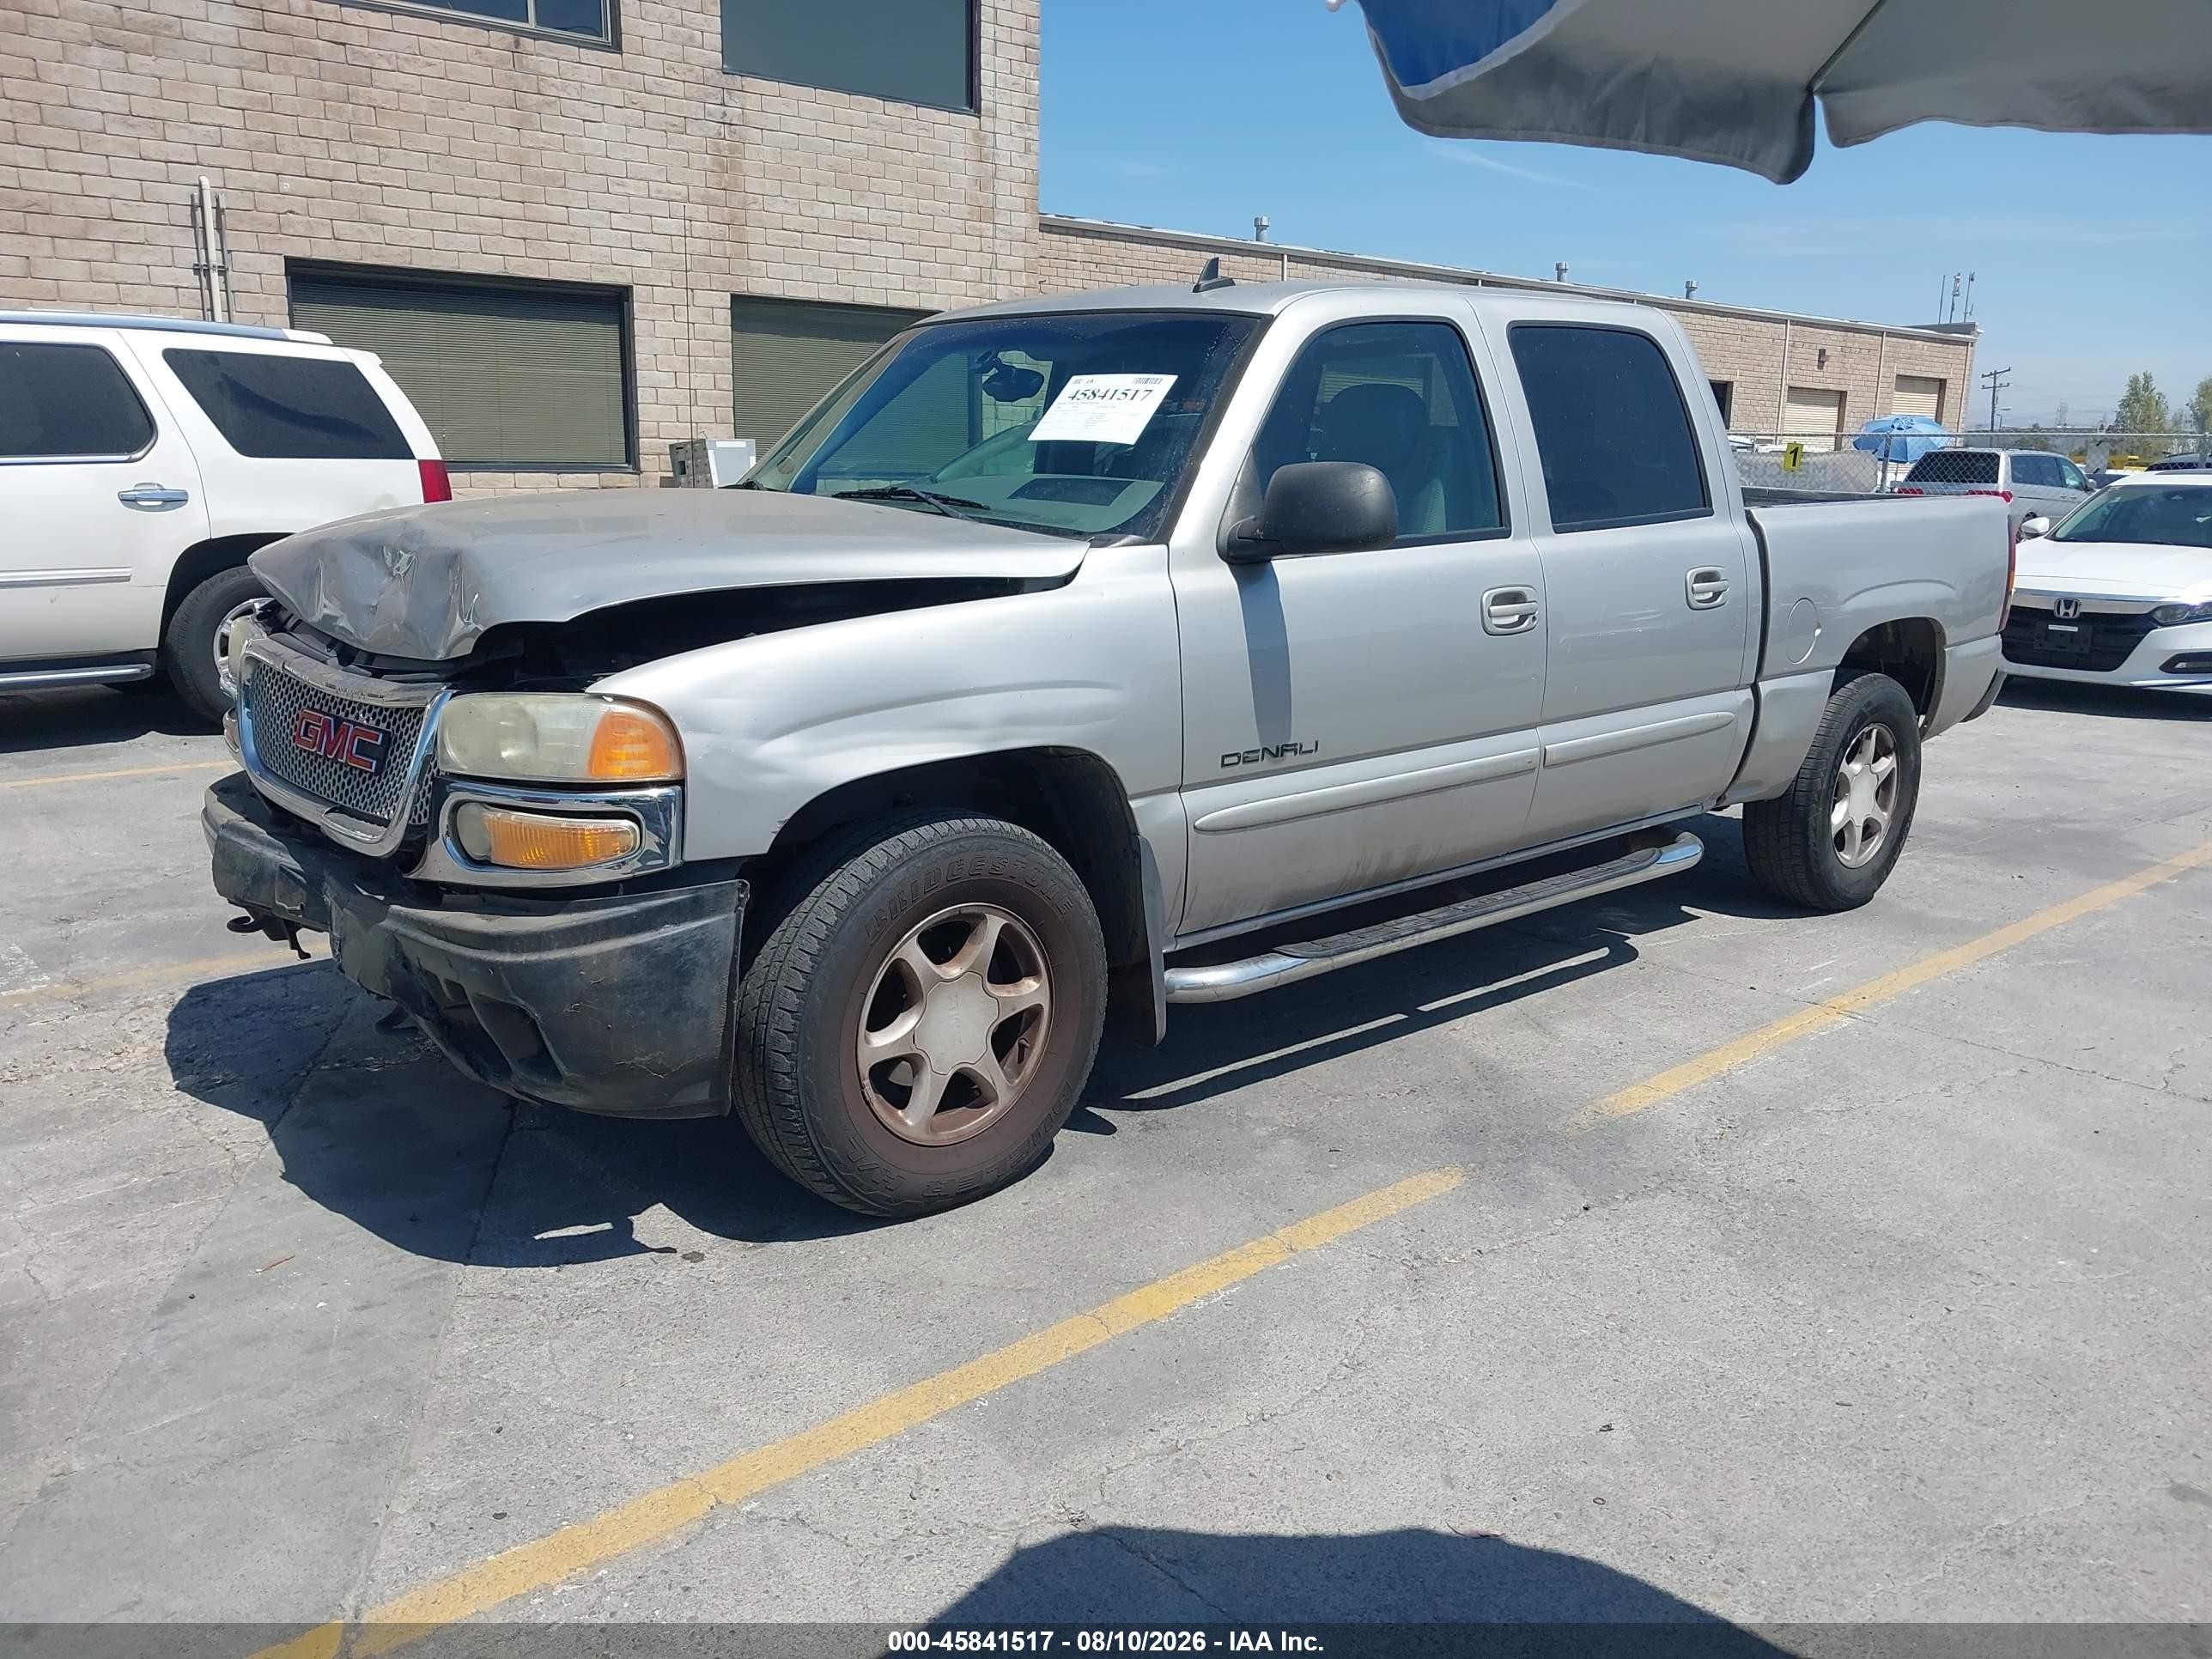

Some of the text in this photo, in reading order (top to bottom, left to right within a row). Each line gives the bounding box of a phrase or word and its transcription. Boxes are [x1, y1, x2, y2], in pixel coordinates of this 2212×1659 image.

[1067, 388, 1154, 401] 45841517
[1790, 447, 1799, 467] 1
[295, 708, 383, 773] GMC
[1220, 739, 1319, 769] DENALI
